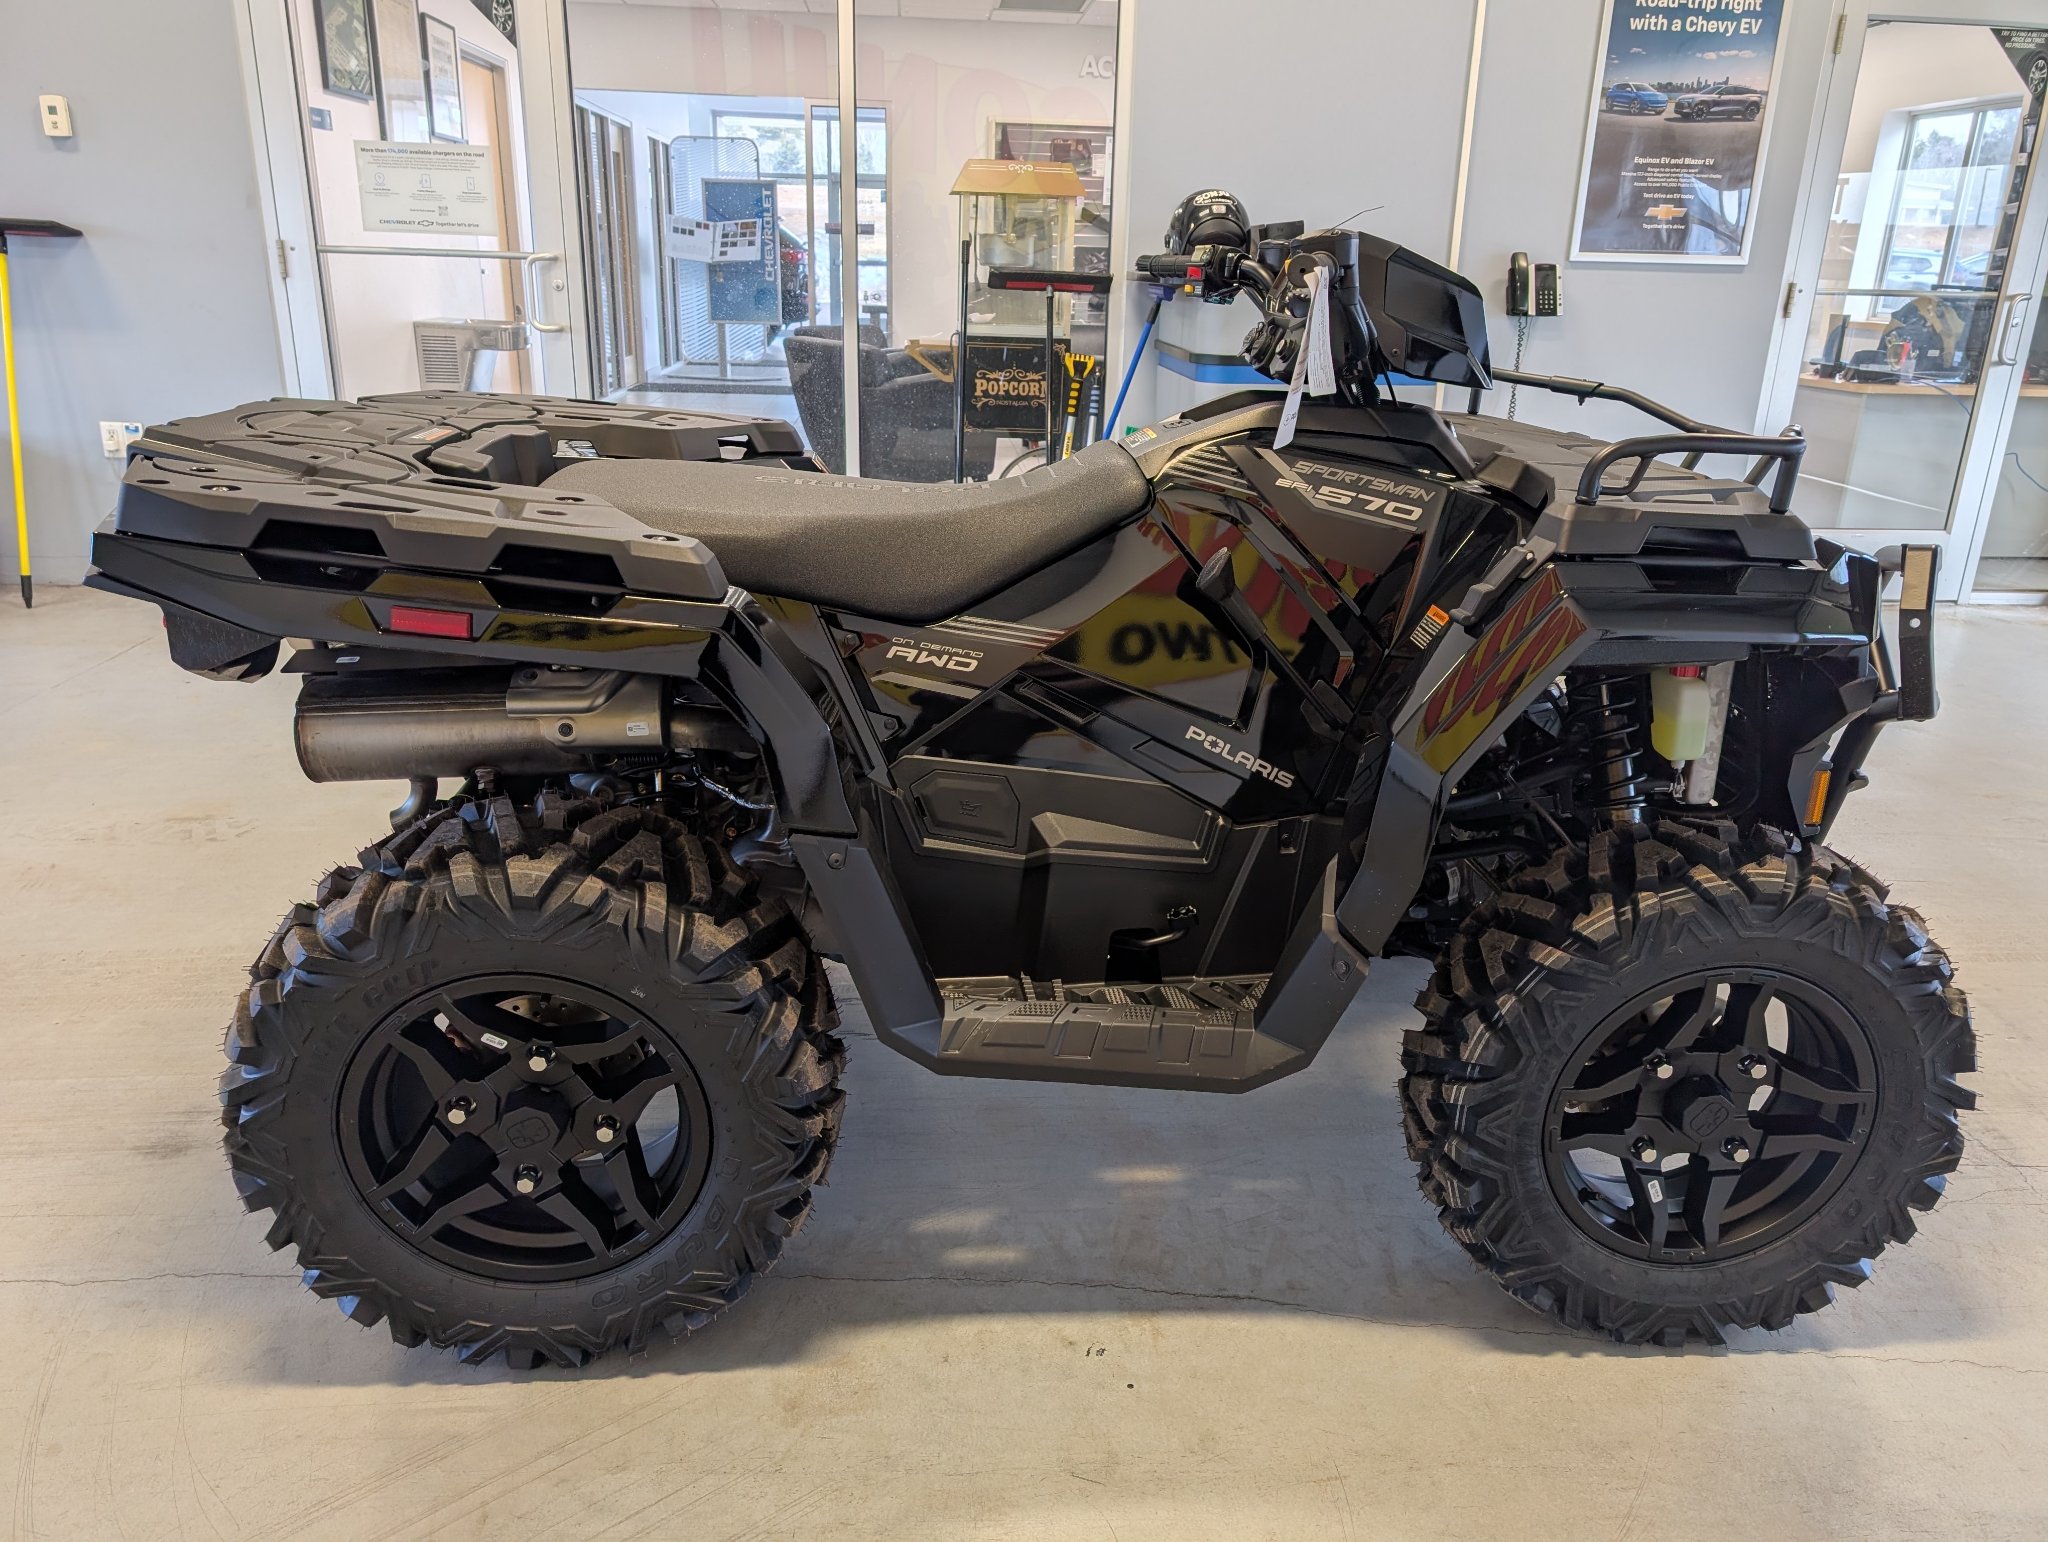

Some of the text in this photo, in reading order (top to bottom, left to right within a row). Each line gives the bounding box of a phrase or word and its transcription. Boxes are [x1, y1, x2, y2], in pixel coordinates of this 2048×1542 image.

[1635, 0, 1762, 14] Road-trip right
[1629, 13, 1763, 37] with a Chevy EV
[1634, 156, 1660, 165] Equinox
[1684, 157, 1705, 165] Blazer
[1705, 158, 1715, 166] EV
[762, 187, 776, 281] CHEVROLET
[1290, 460, 1437, 502] SPORTSMAN
[1274, 478, 1423, 521] EFI 570
[885, 645, 979, 672] AWD
[892, 636, 984, 658] ON DEMAND
[1184, 725, 1296, 789] POLARIS
